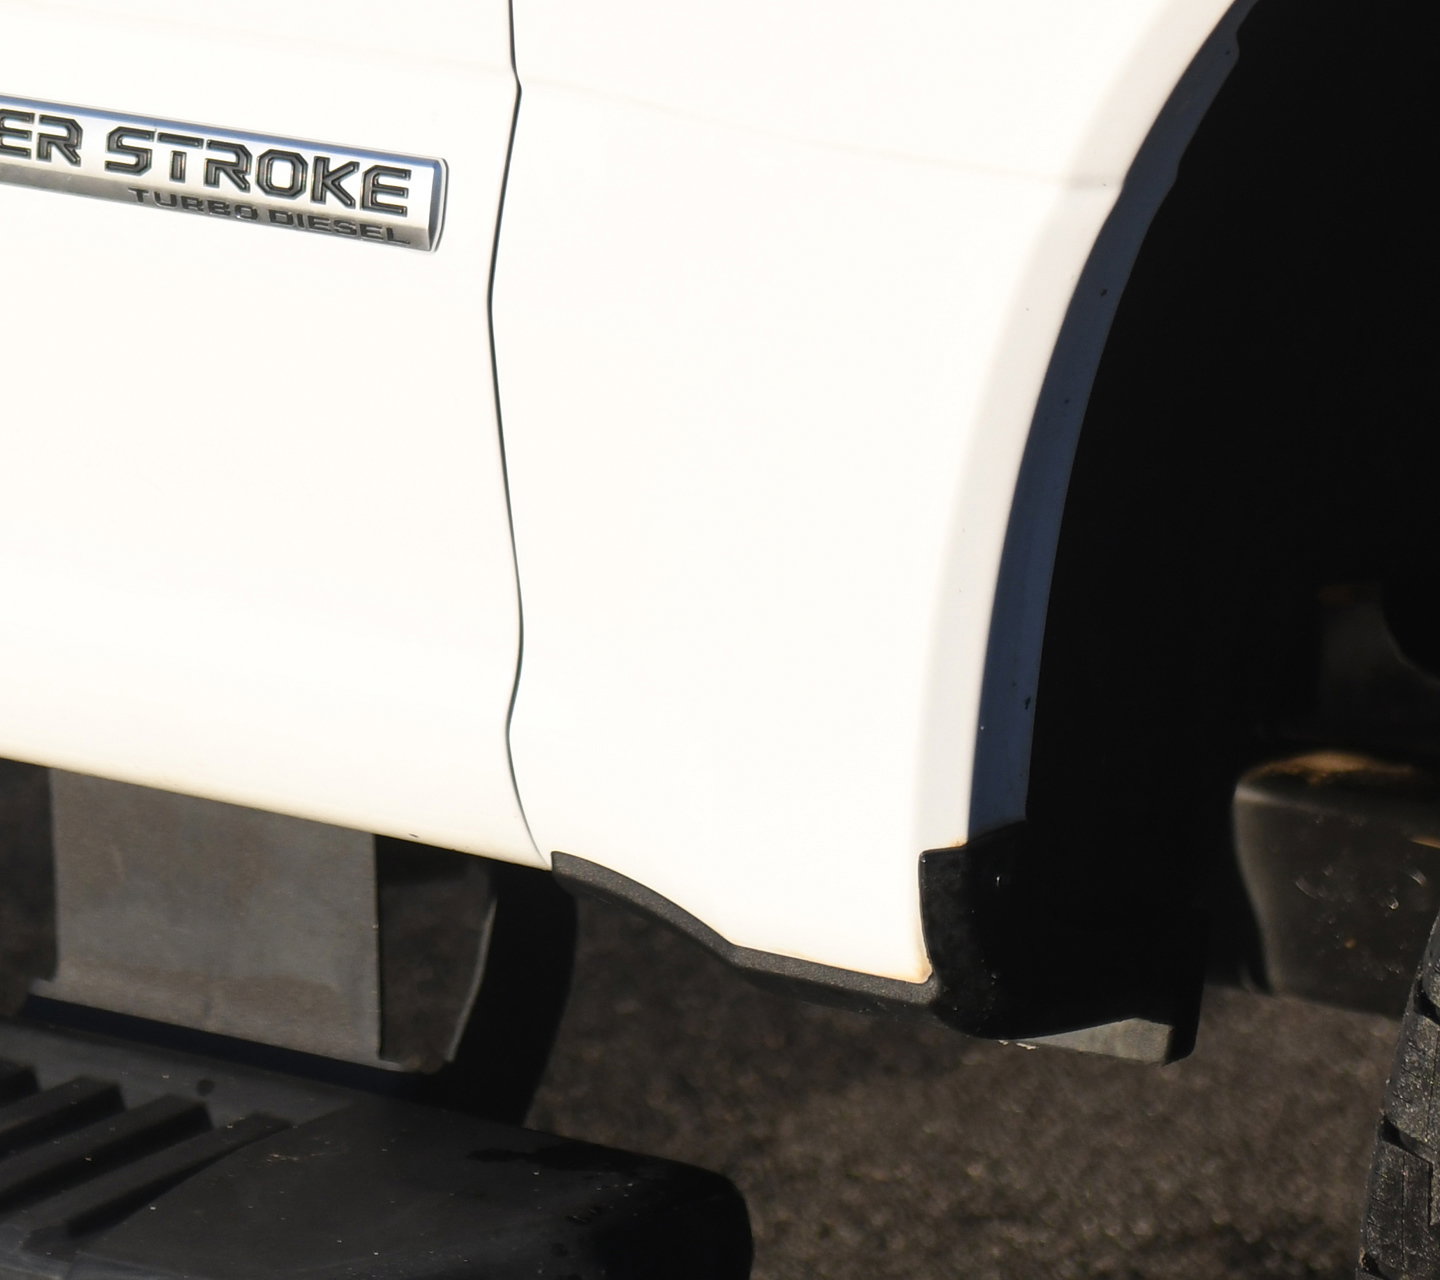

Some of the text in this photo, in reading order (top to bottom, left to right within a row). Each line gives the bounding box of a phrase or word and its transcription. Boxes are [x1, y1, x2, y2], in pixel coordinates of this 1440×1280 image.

[104, 125, 414, 219] STROKE
[128, 186, 412, 246] TURBO DIESEL
